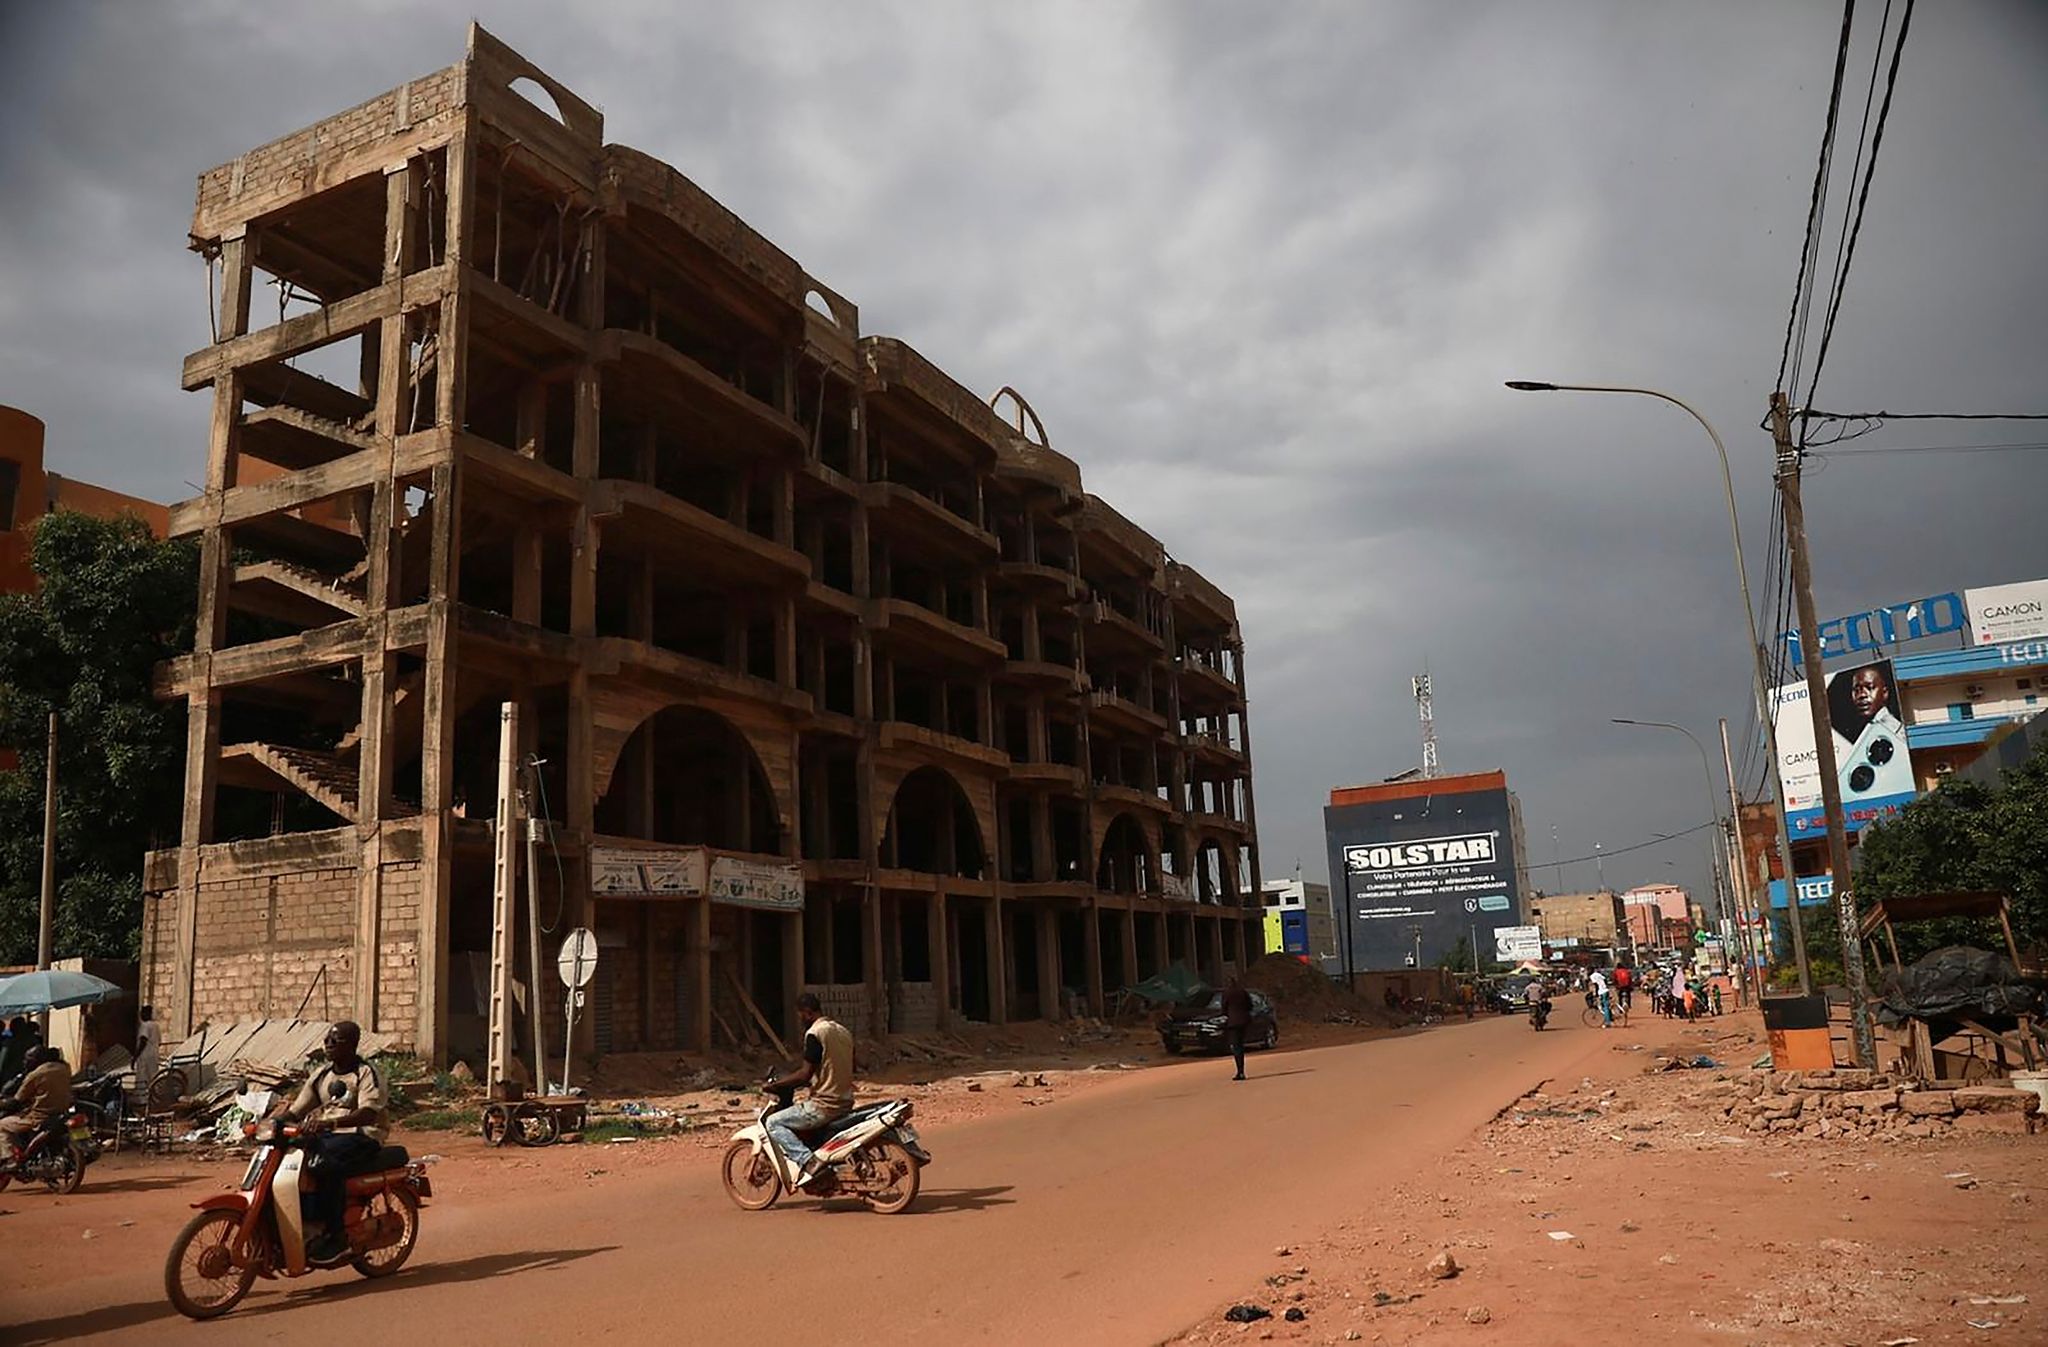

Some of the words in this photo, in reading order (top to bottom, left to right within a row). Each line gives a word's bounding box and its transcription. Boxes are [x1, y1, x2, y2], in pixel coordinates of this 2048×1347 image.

[1983, 601, 2042, 619] CAMON
[1785, 750, 1819, 766] CAMO
[1349, 839, 1491, 869] SOLSTAR
